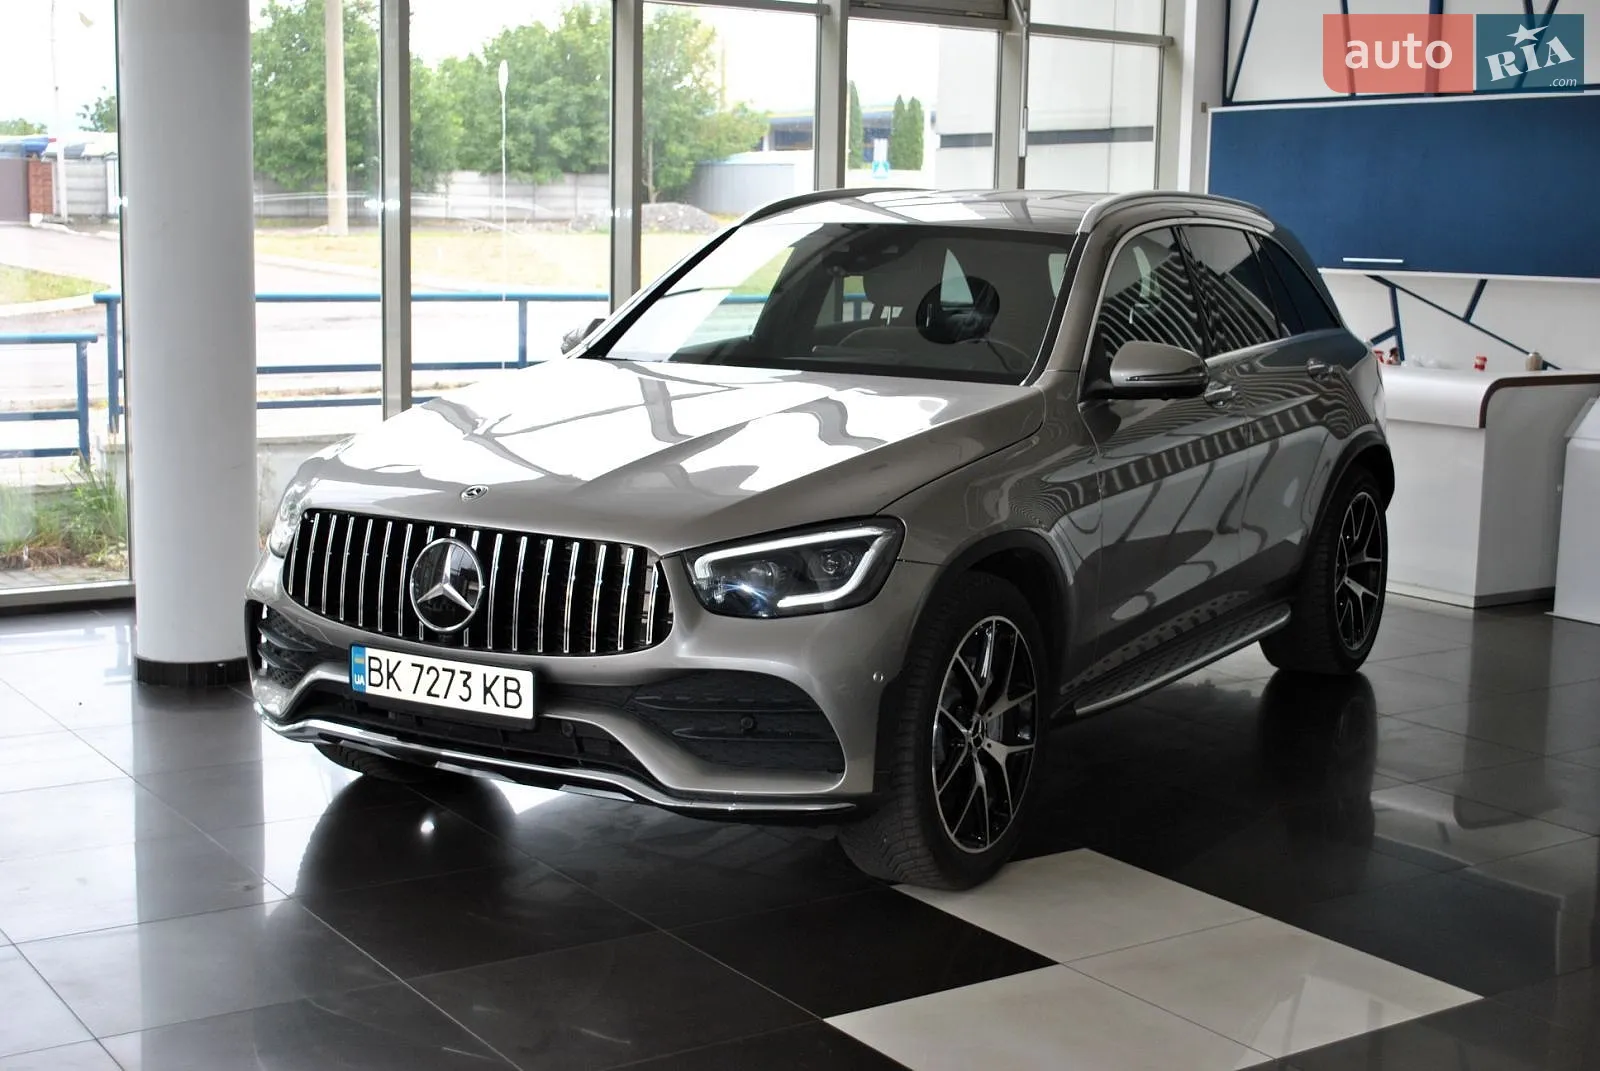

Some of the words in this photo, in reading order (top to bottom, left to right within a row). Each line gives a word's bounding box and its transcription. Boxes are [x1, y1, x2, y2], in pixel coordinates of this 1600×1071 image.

[354, 674, 365, 686] UA
[368, 656, 402, 692] BK
[411, 663, 472, 702] 7273
[483, 673, 523, 709] KB
